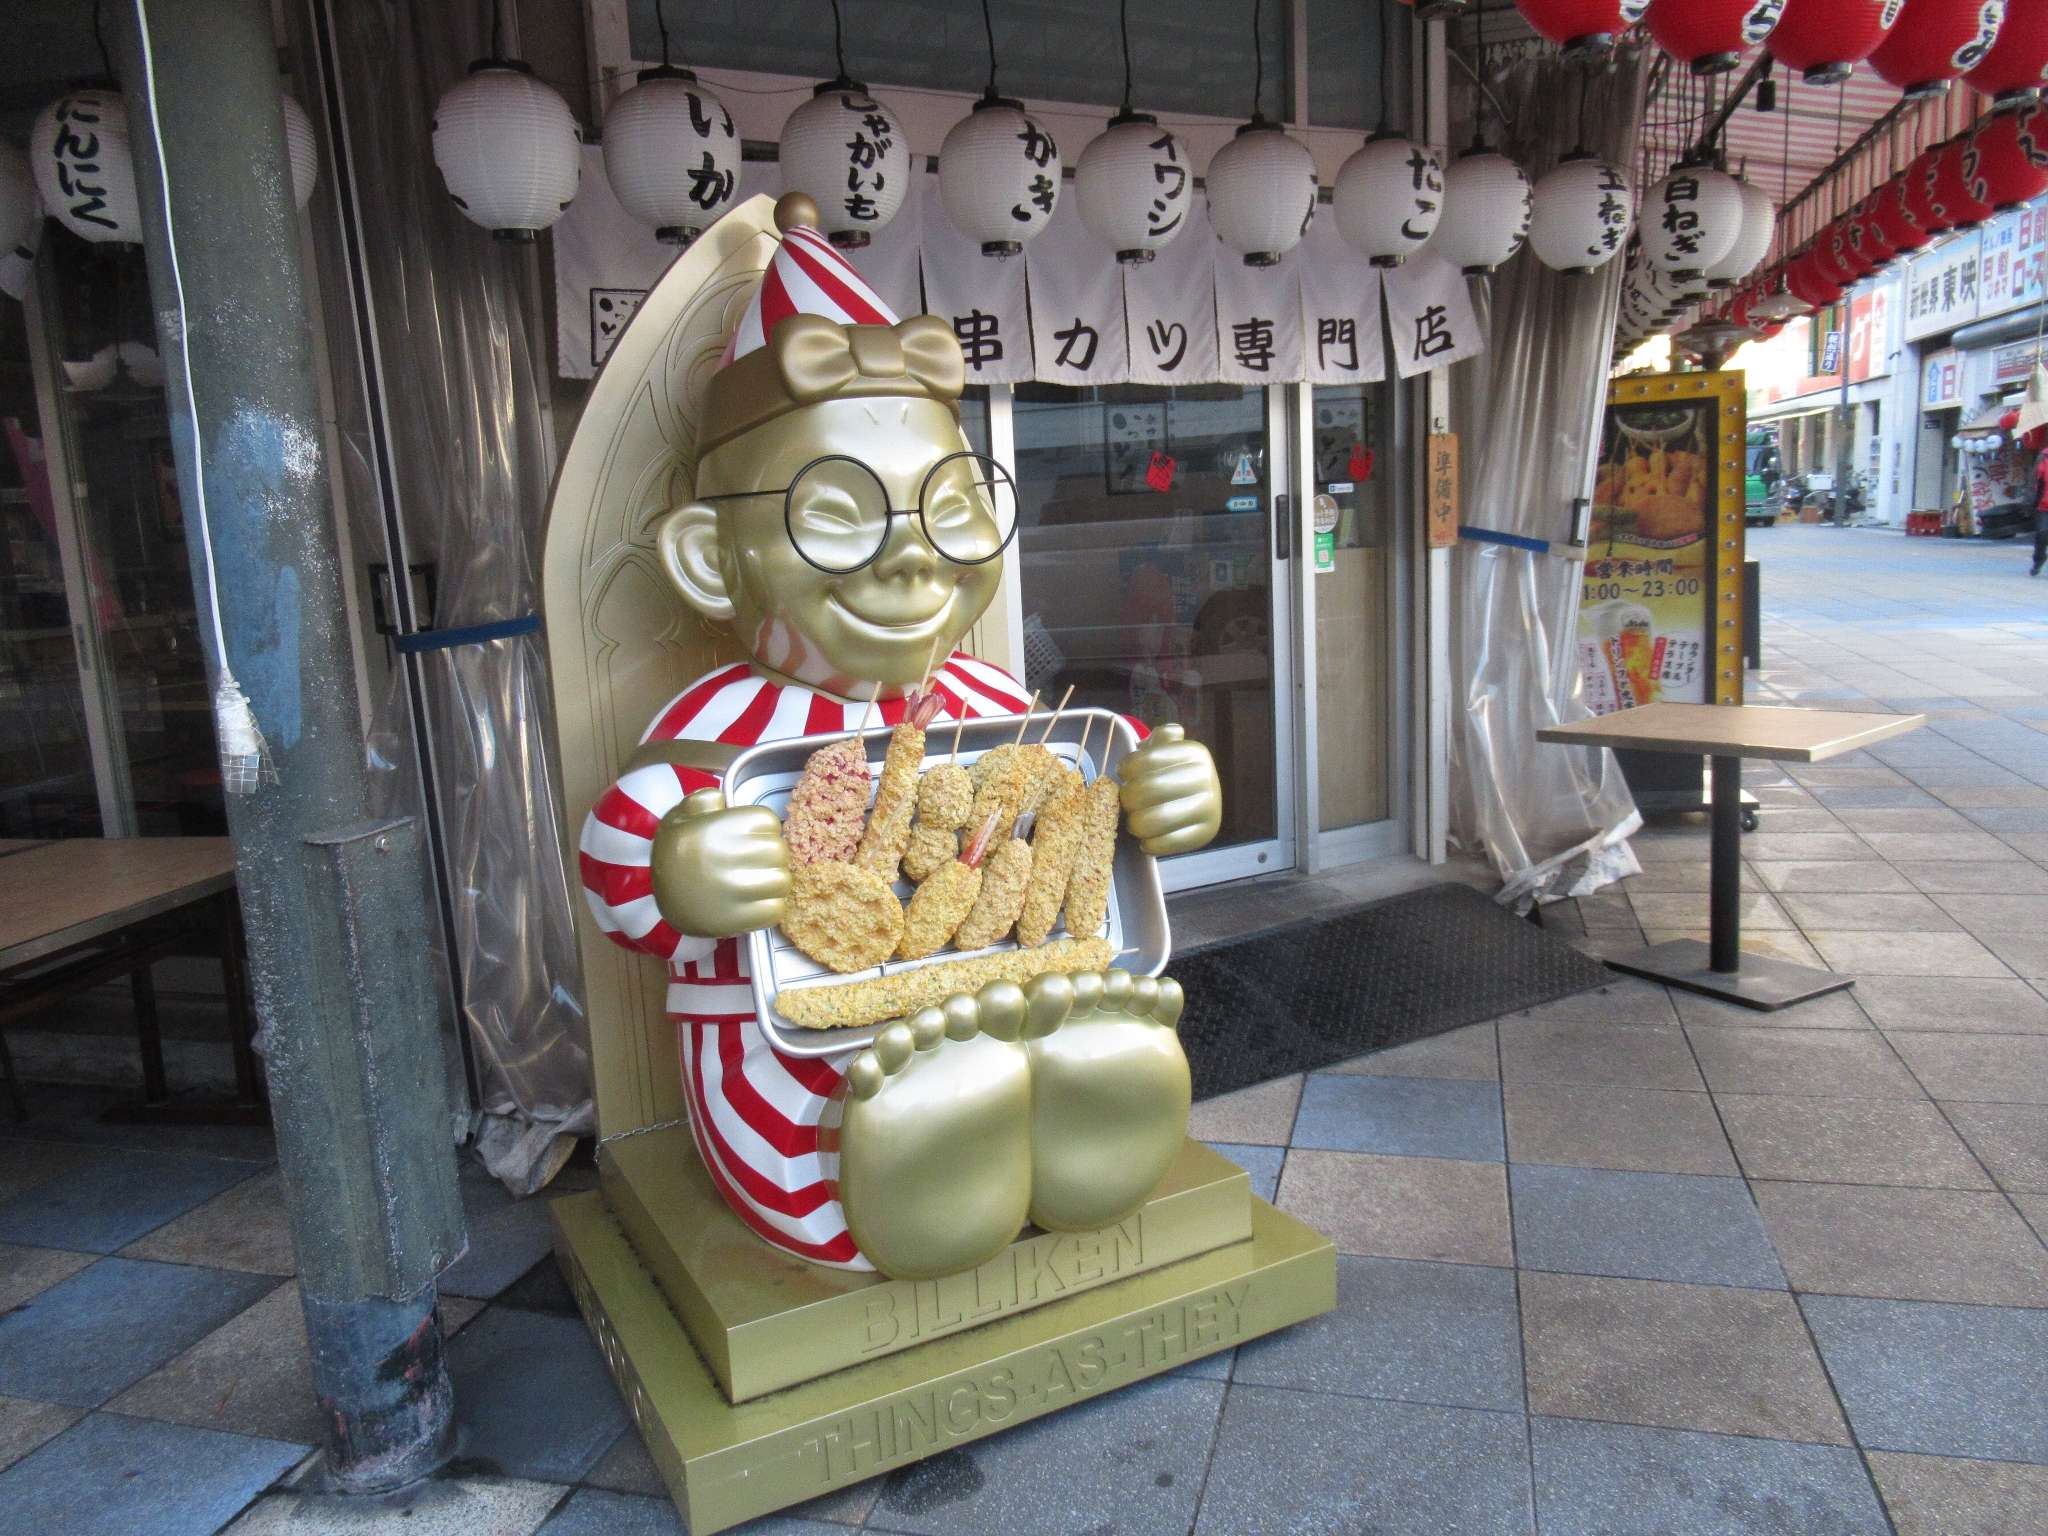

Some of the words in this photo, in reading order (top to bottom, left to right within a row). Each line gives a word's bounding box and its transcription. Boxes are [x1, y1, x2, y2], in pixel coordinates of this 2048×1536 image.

[685, 92, 735, 210] いか
[1011, 118, 1058, 222] かき
[1147, 132, 1187, 237] イワシ
[1402, 148, 1442, 241] たこ
[1662, 175, 1706, 262] 白ねぎ
[952, 305, 1455, 372] 串カツ専門店
[1434, 450, 1453, 522] 準備中
[861, 1211, 1144, 1354] BILLIKEN
